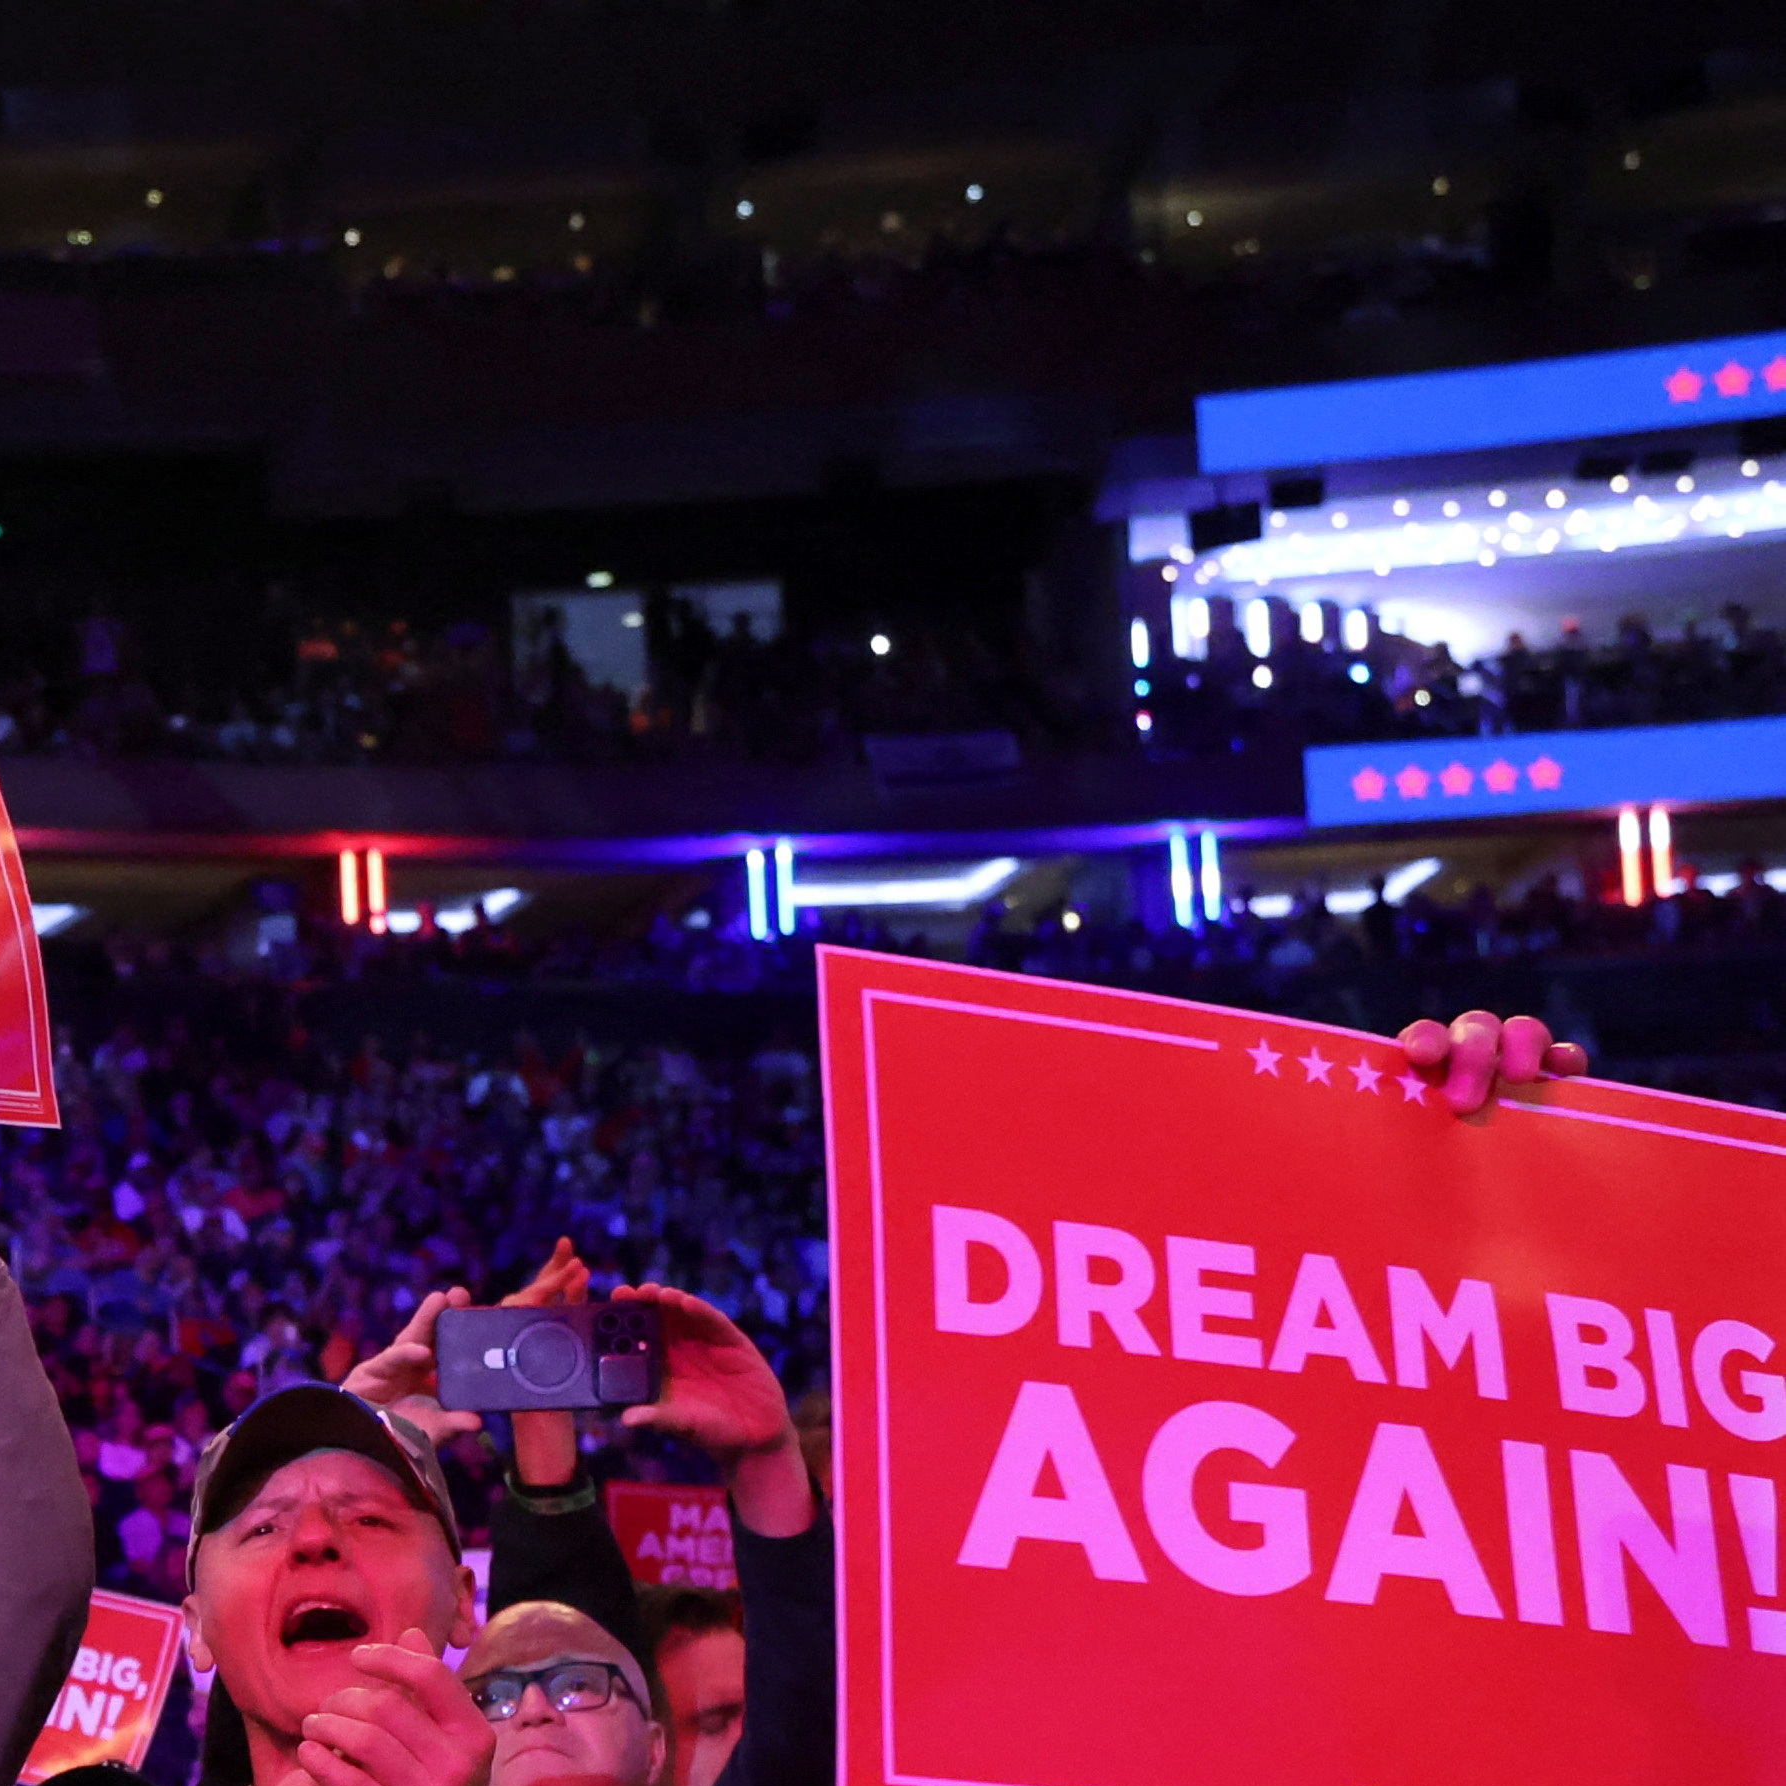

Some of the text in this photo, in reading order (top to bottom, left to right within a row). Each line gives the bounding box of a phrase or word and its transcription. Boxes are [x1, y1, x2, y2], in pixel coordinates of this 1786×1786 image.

[930, 1204, 1508, 1400] DREAM
[957, 1380, 1786, 1655] AGAIN!
[70, 1647, 148, 1700] BIG,
